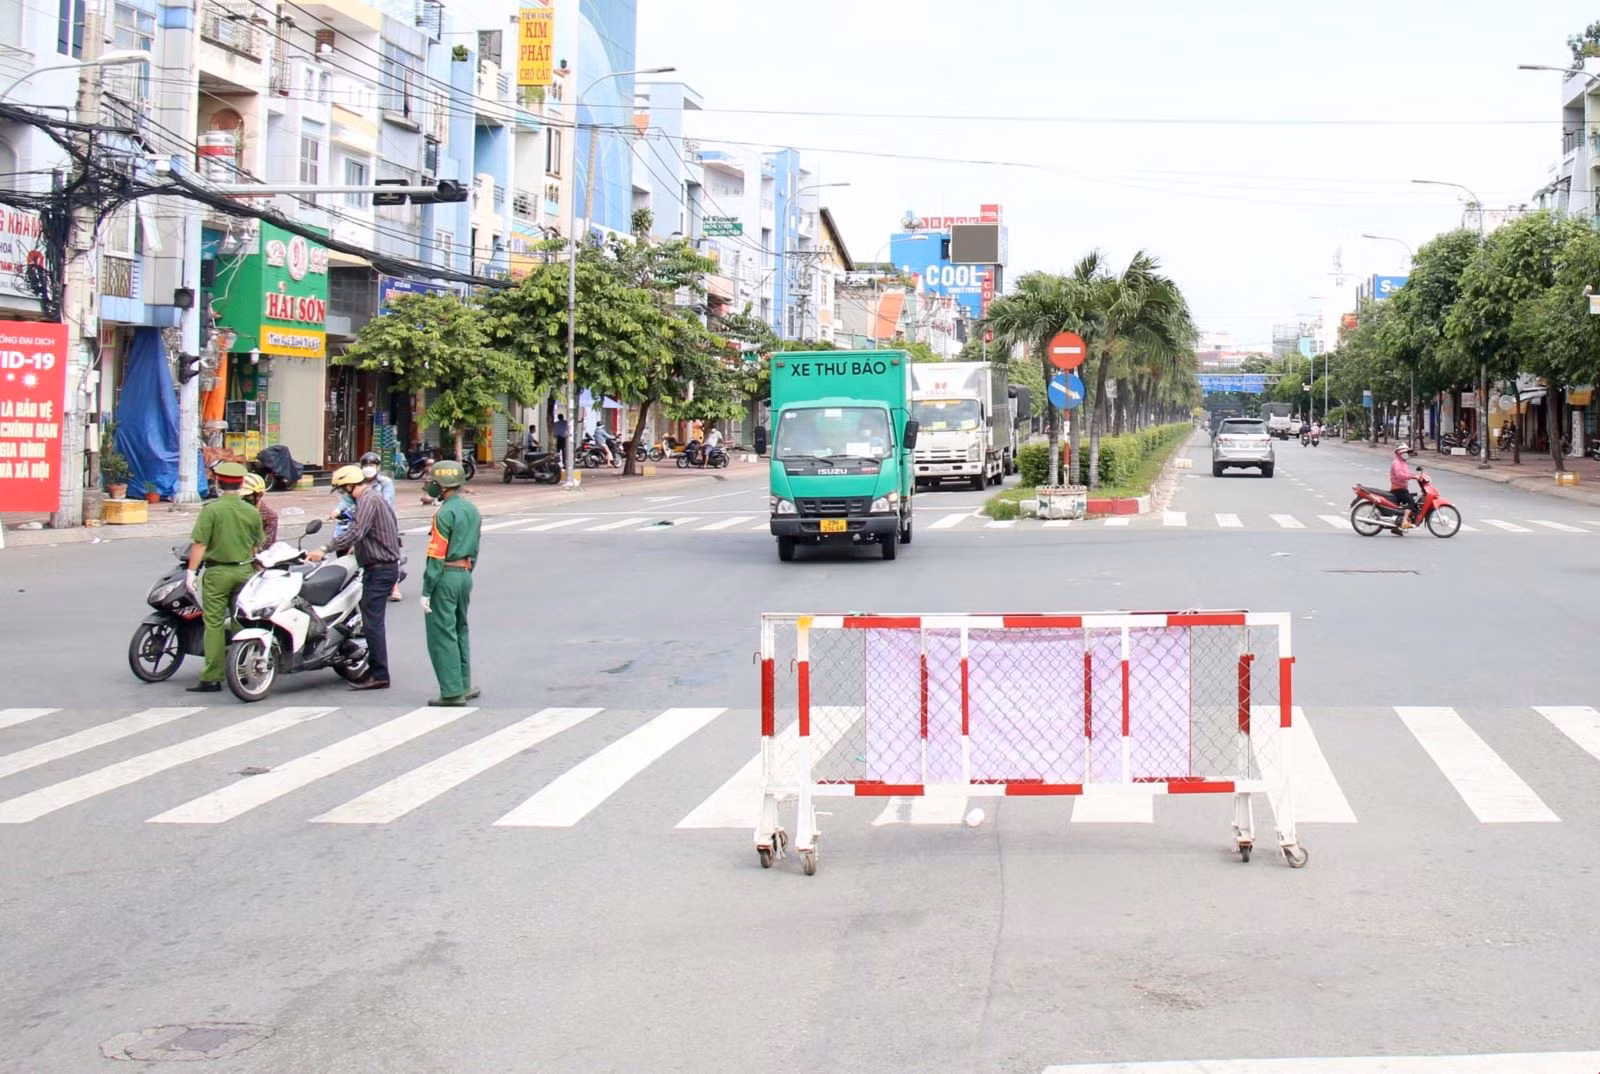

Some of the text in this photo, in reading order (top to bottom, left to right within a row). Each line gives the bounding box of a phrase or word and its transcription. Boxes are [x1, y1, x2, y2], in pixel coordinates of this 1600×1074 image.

[526, 22, 547, 38] KIM
[521, 40, 551, 61] PHÁT
[267, 282, 325, 324] HẢI SƠN
[34, 337, 55, 347] DỊCH
[0, 351, 56, 370] ID-19
[791, 358, 886, 376] XE THƯ BÁO
[36, 422, 58, 441] BẠN
[15, 460, 29, 478] XÃ
[32, 460, 50, 482] HỘI
